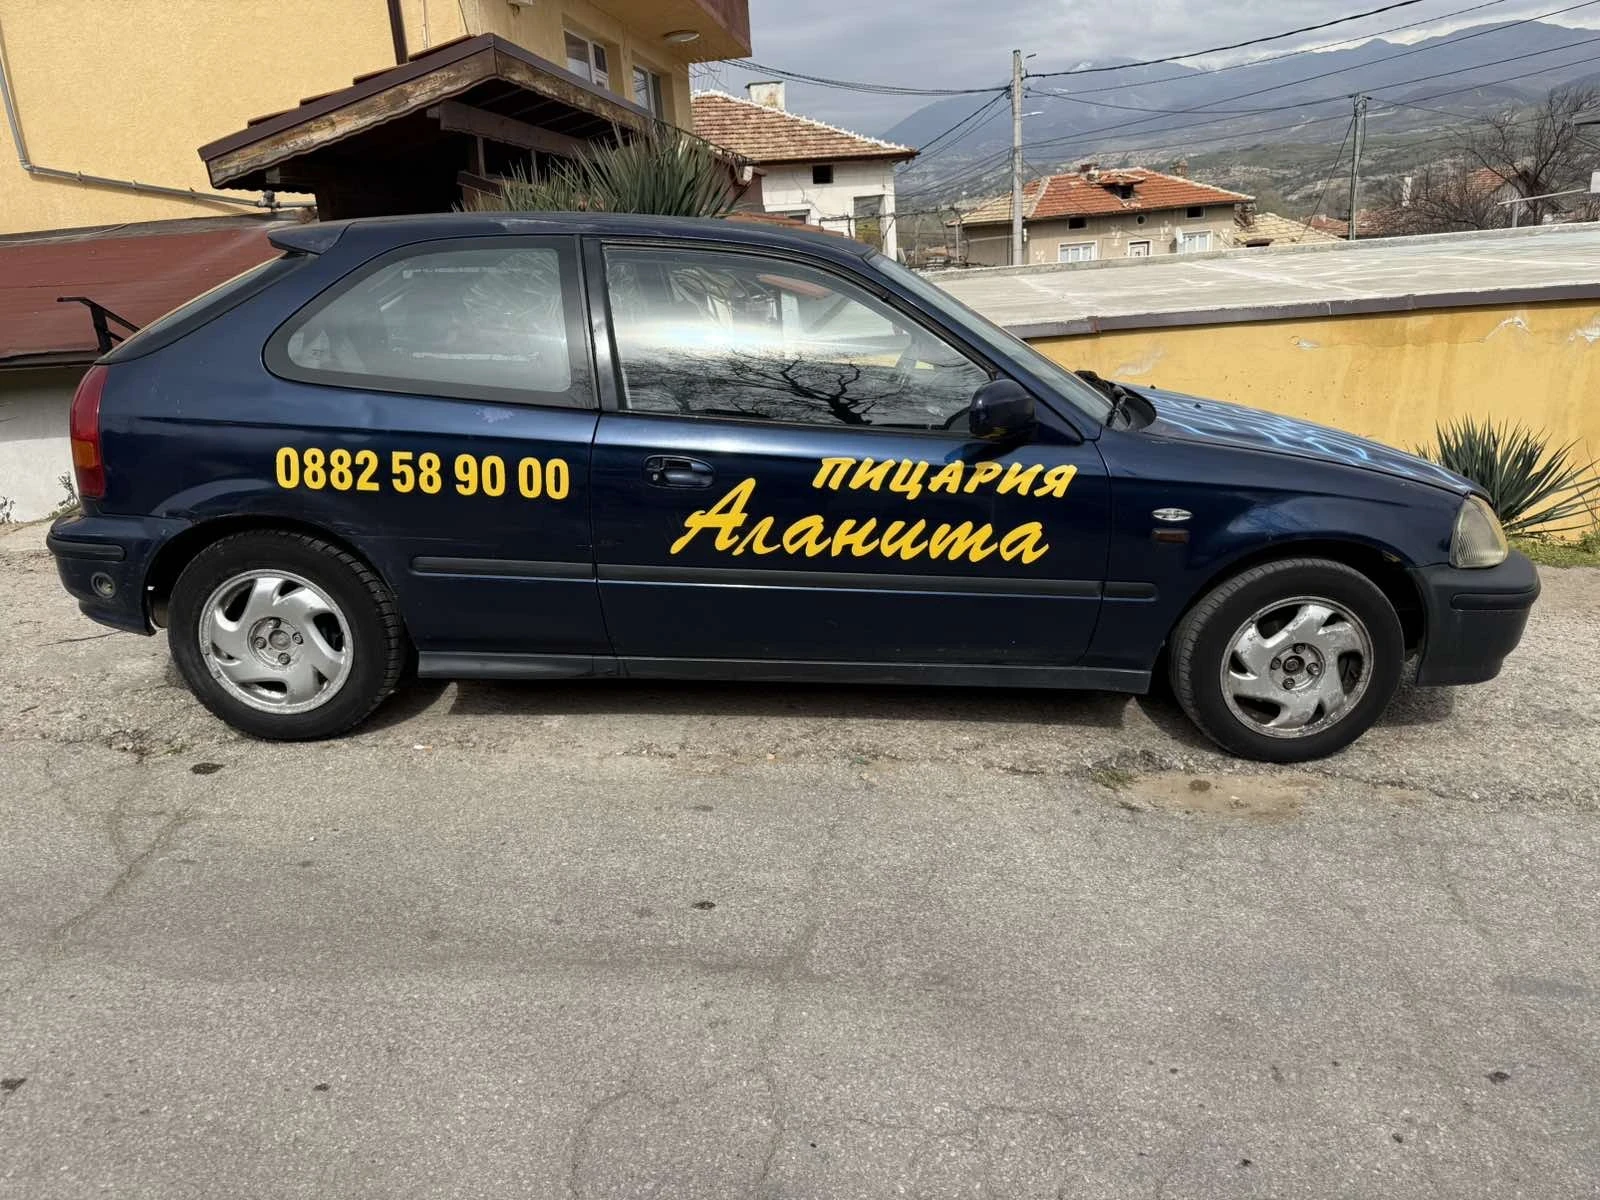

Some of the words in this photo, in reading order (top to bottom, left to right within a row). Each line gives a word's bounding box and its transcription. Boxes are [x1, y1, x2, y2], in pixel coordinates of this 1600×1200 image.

[275, 446, 380, 492] 0882
[391, 452, 442, 495] 58
[454, 455, 506, 497] 90
[518, 458, 570, 500] 00
[813, 457, 1076, 500] ПИЦАРИЯ
[669, 477, 1049, 565] Аланита
